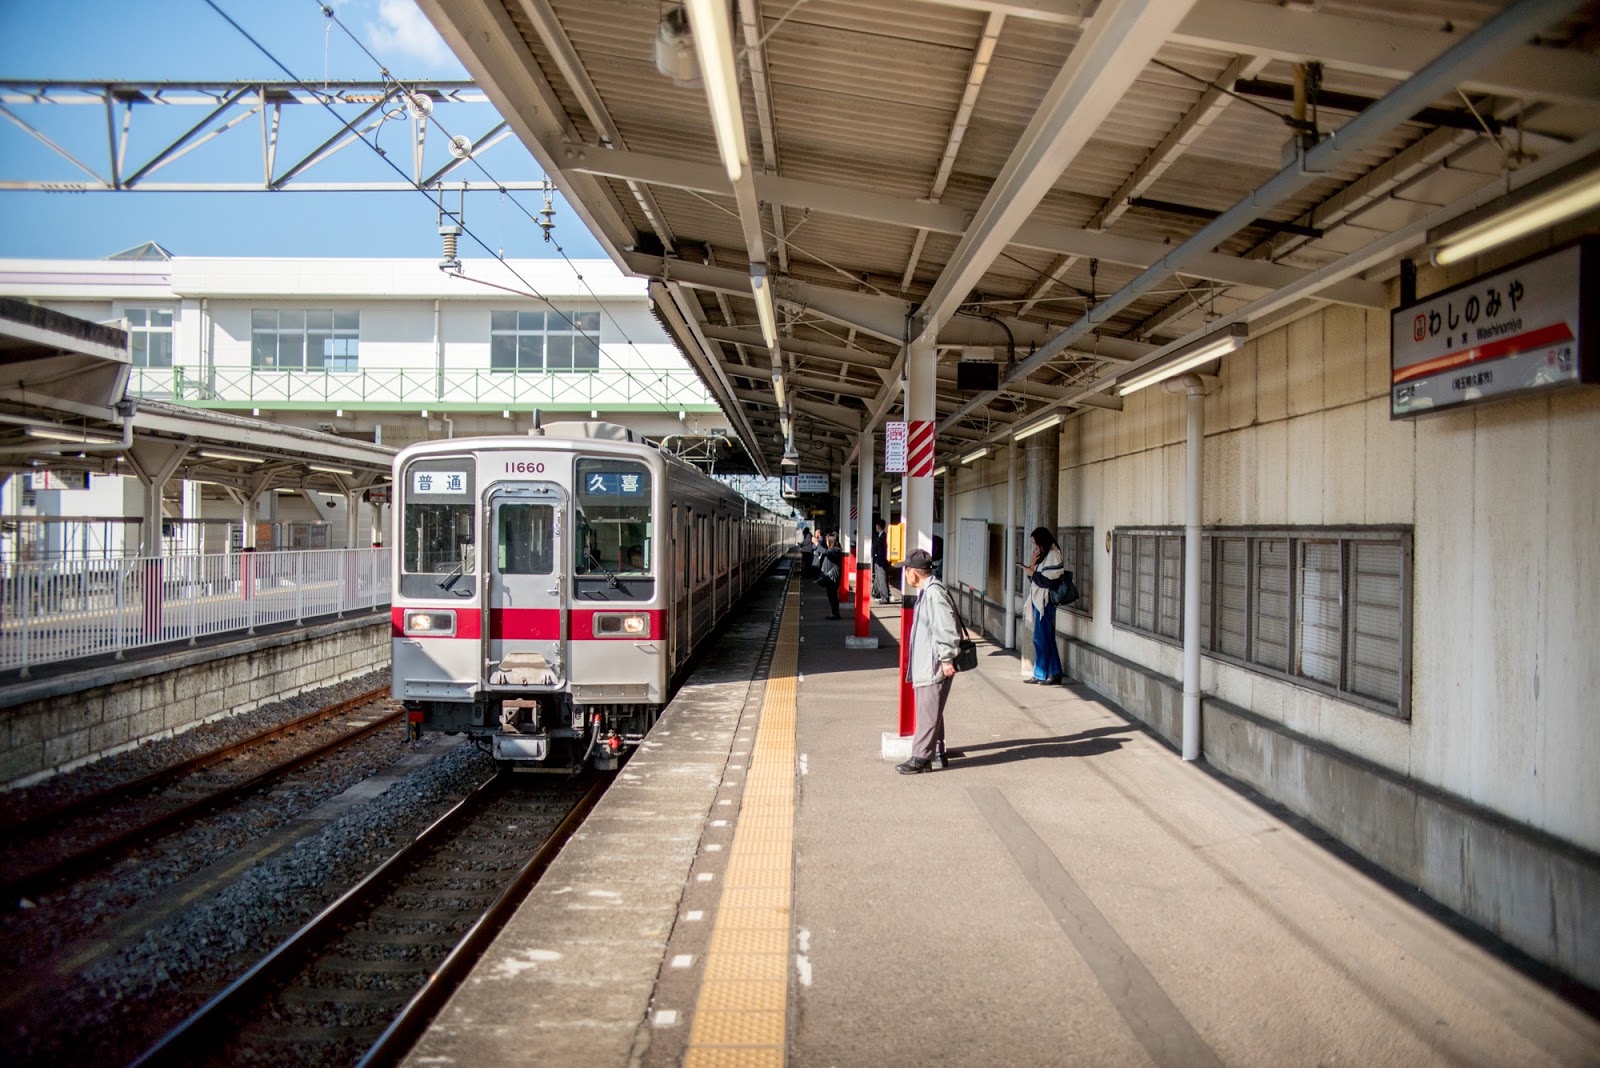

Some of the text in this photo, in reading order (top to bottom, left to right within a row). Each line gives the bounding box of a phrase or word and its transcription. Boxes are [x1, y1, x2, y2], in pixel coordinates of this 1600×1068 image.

[1429, 280, 1524, 337] わしのみや
[1477, 318, 1522, 340] Washinomiya
[505, 462, 545, 473] 11660
[418, 475, 462, 491] 普通
[590, 474, 639, 492] 久喜
